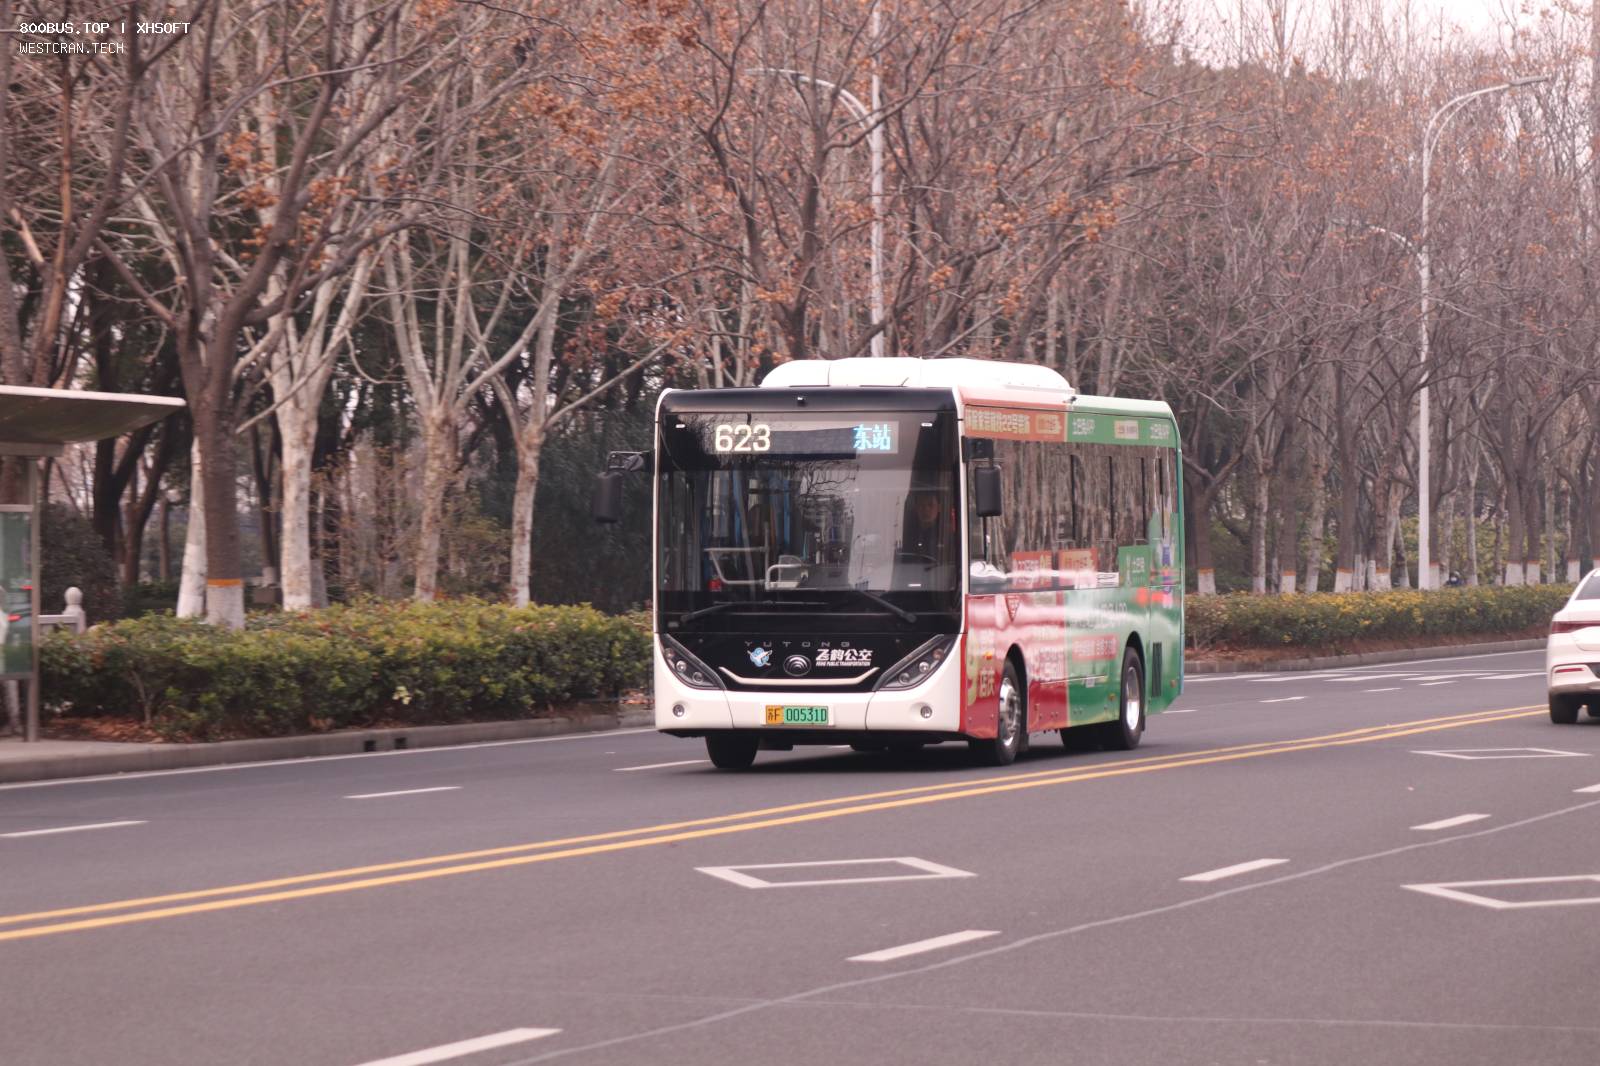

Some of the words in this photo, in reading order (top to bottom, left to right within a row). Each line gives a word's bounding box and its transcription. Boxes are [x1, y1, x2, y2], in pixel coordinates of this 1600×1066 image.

[715, 424, 771, 452] 623
[853, 423, 891, 451] 东站
[744, 640, 850, 648] YUTONG
[815, 648, 873, 661] 飞鹤公交
[786, 708, 827, 722] 00531D
